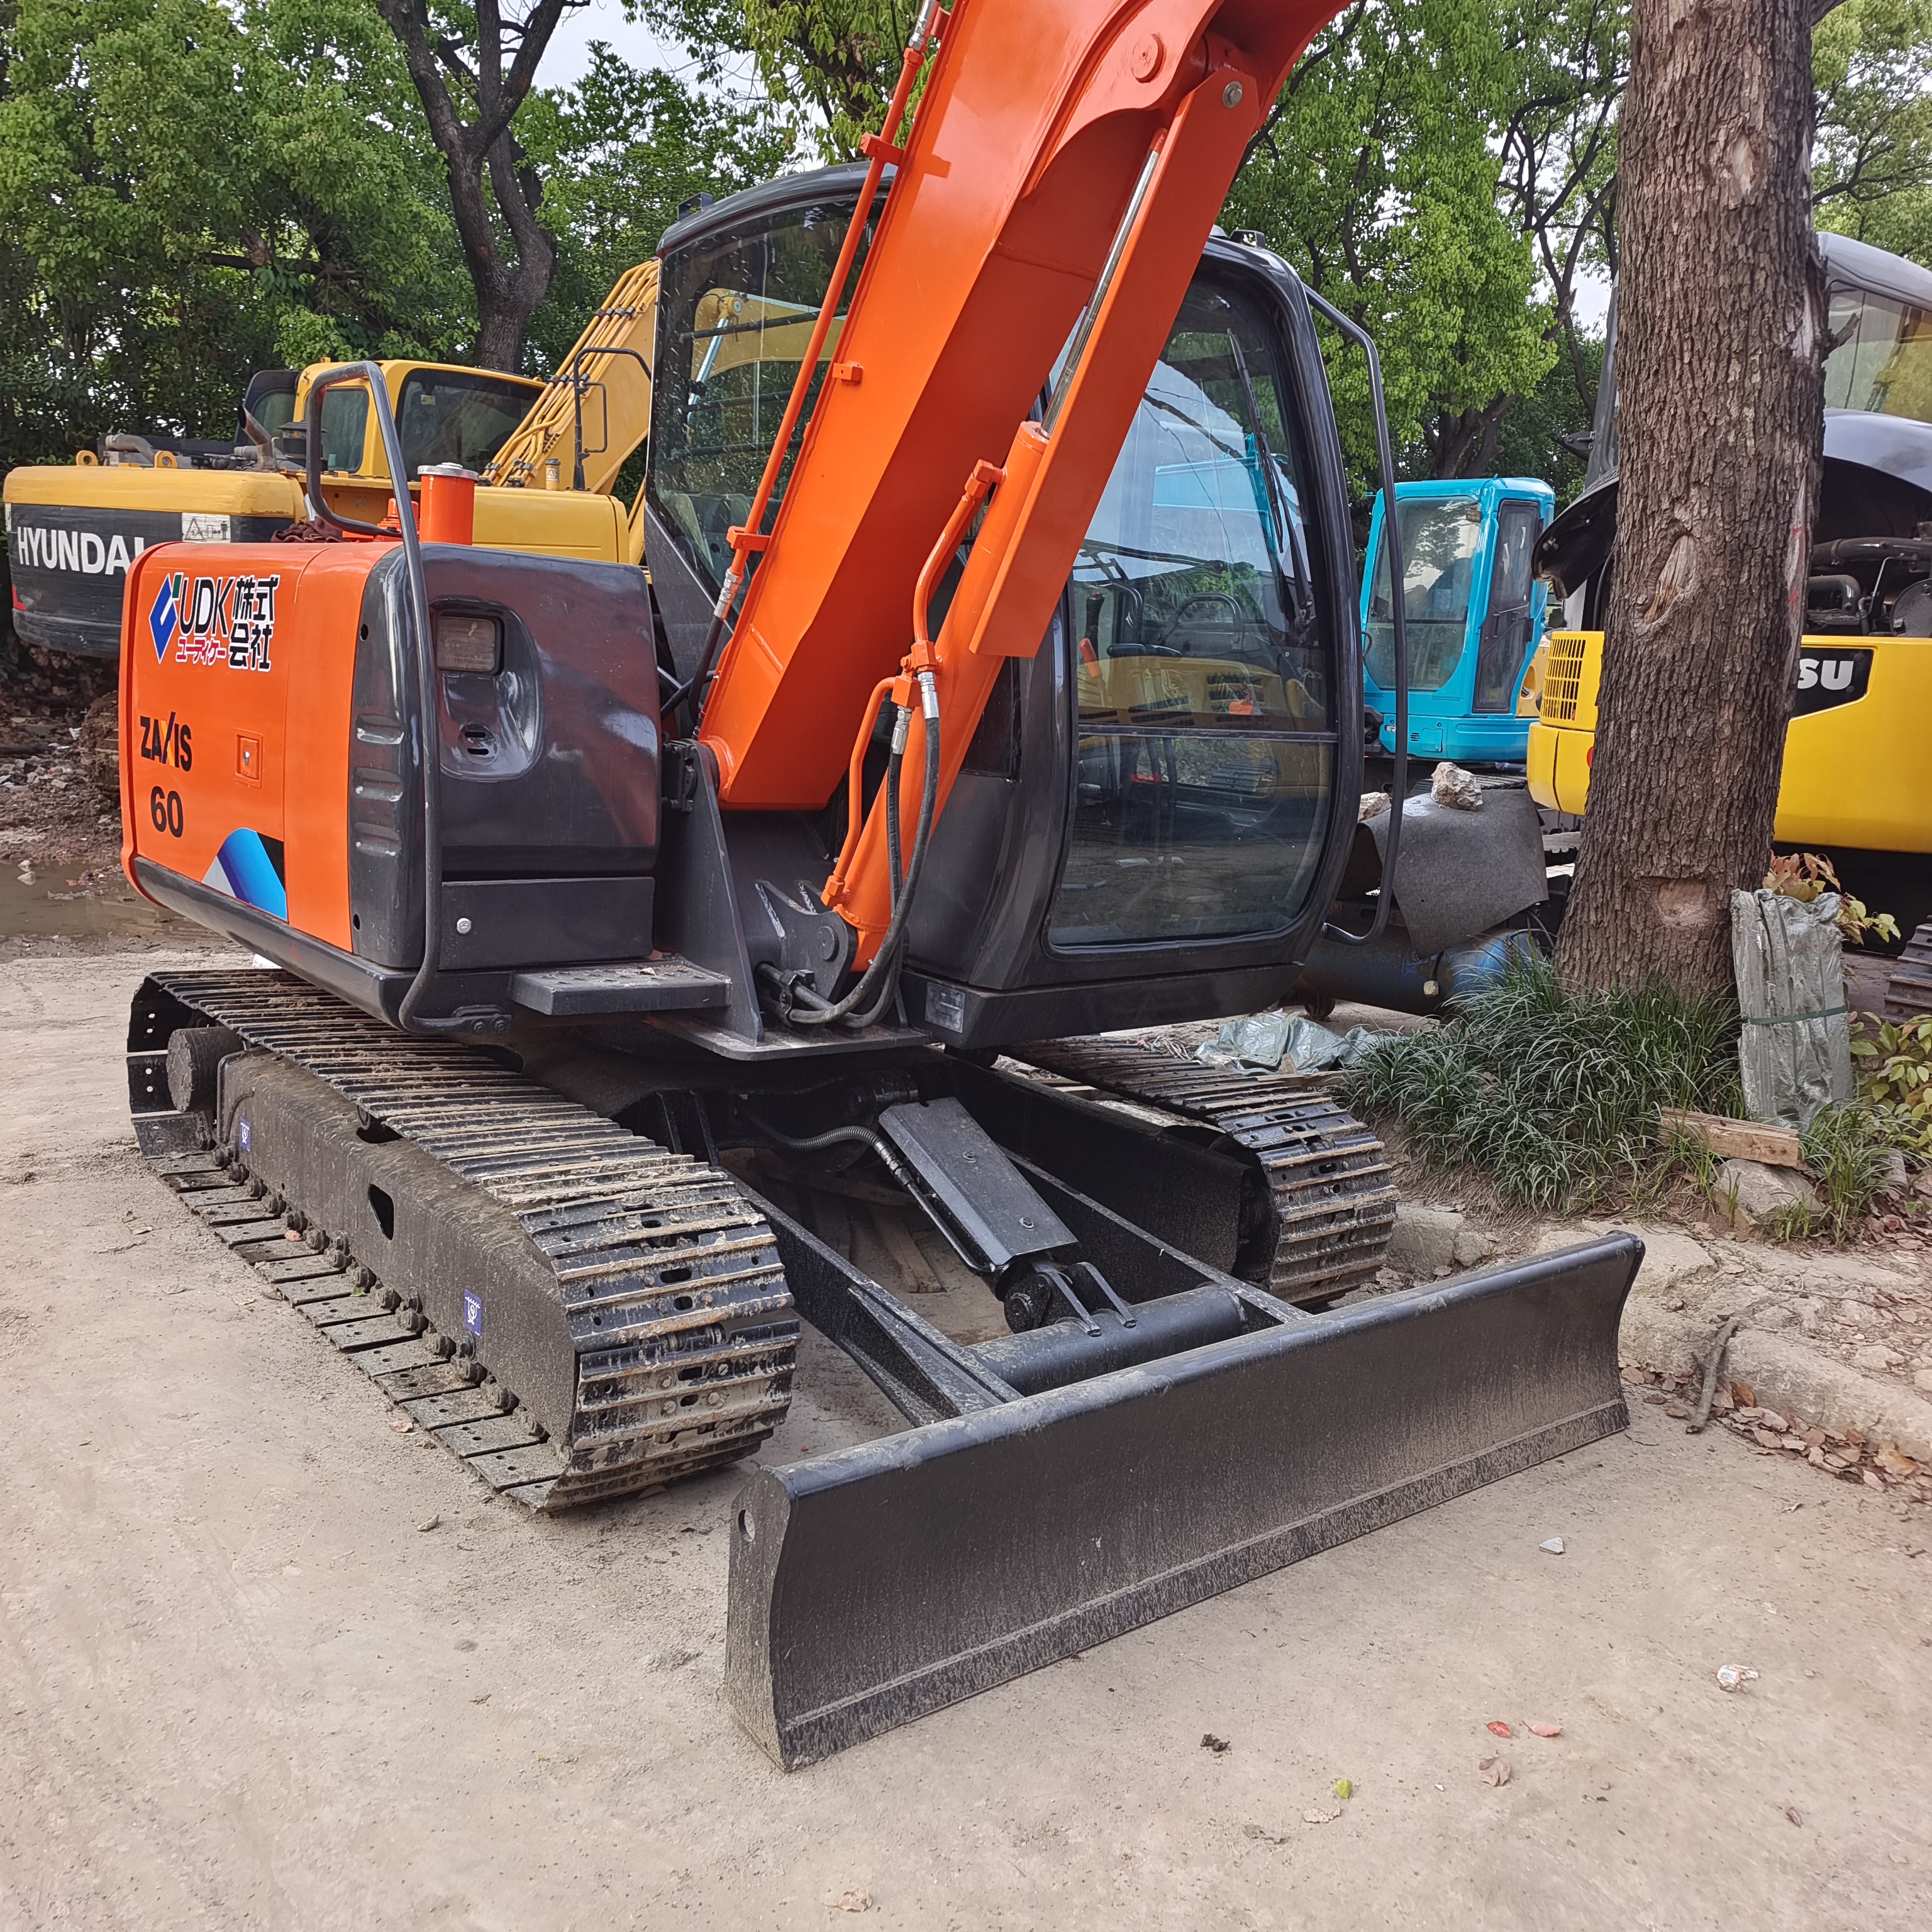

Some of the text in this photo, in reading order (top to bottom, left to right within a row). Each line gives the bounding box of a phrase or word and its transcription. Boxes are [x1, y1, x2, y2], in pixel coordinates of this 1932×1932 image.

[179, 578, 235, 635] UDK
[233, 576, 279, 621] 株式
[230, 623, 272, 670] 会社
[1797, 658, 1854, 690] SU
[140, 711, 192, 772] ZAXIS
[150, 786, 184, 838] 60
